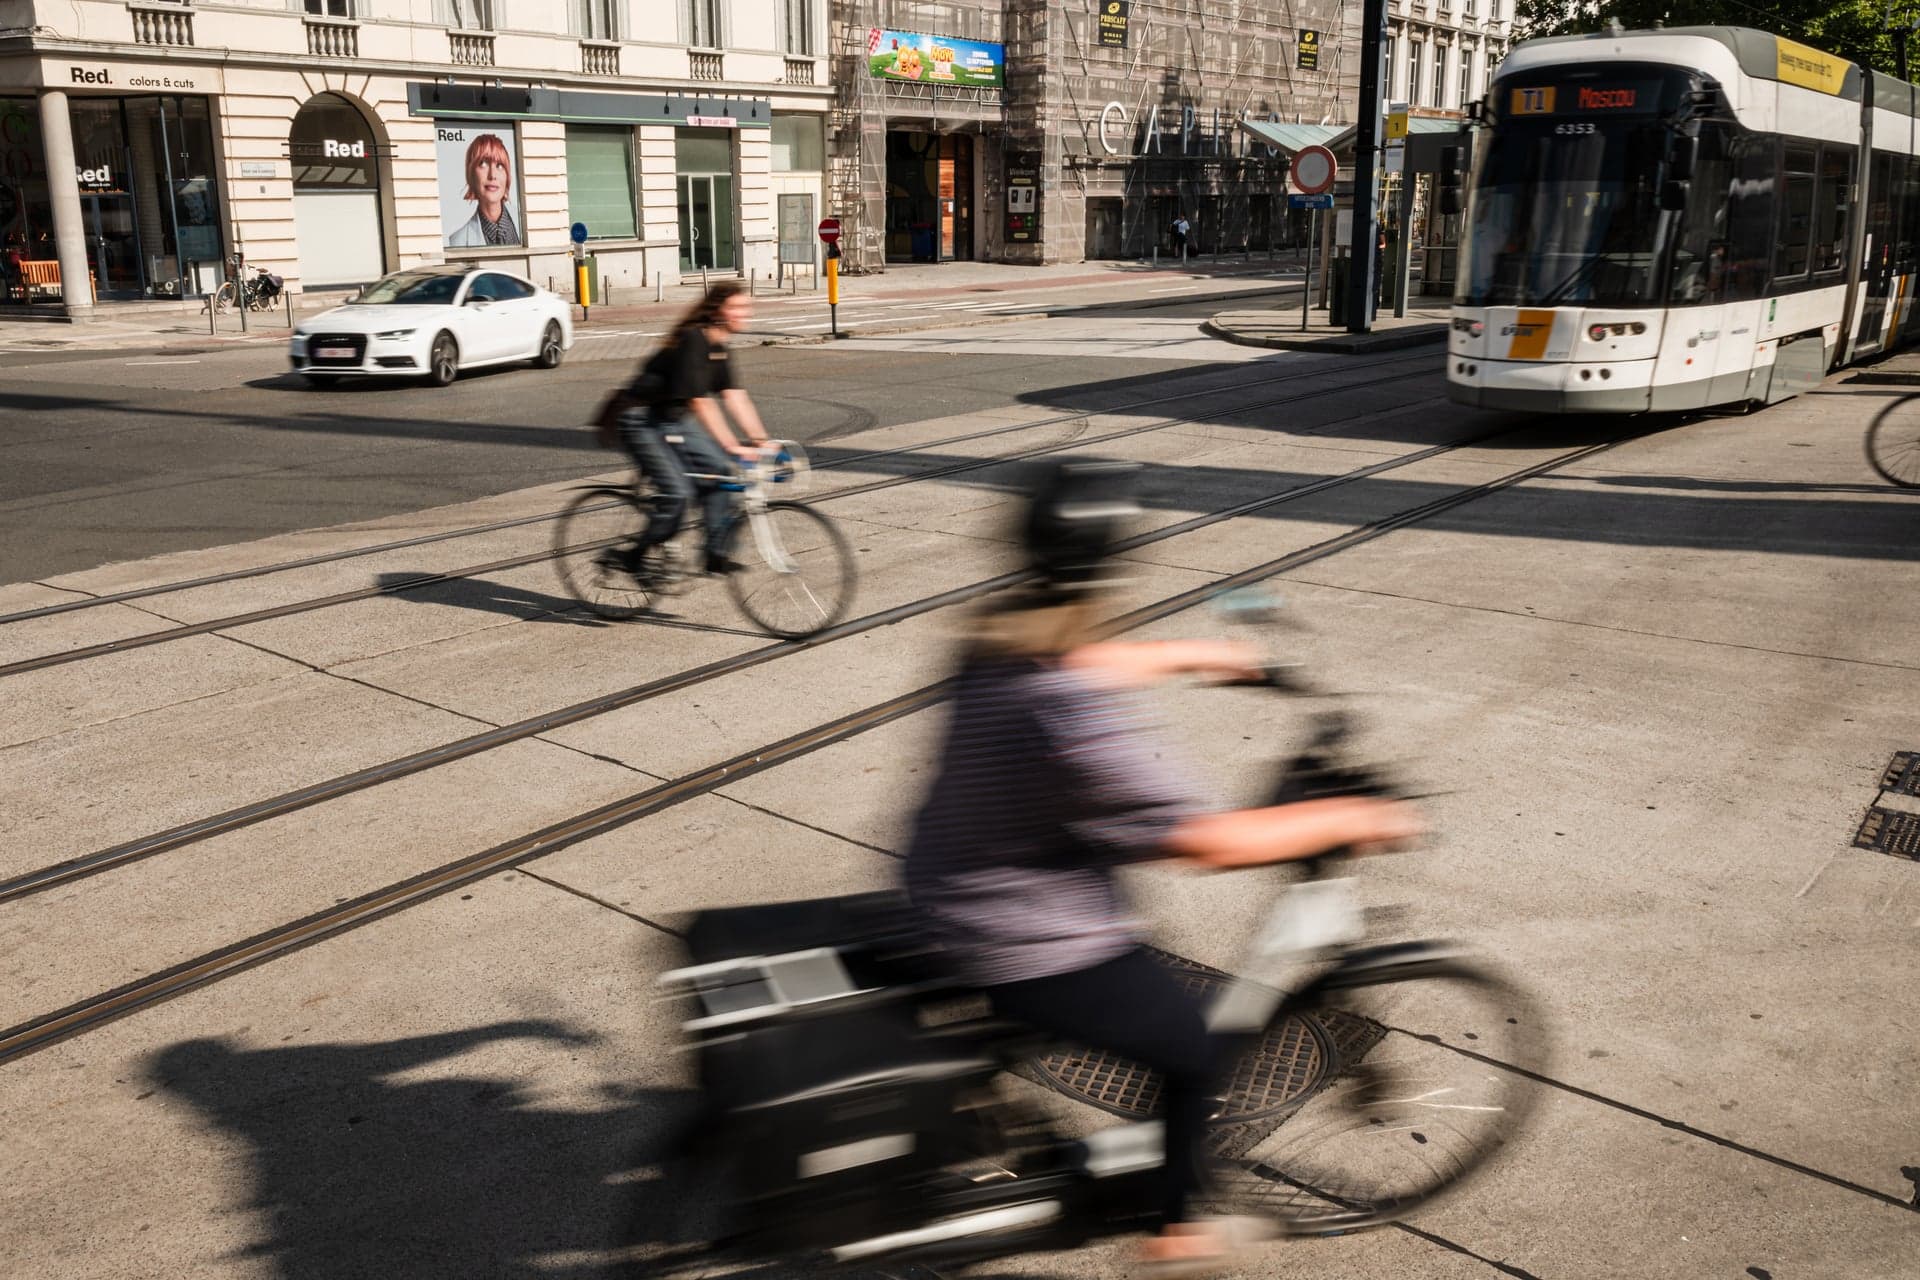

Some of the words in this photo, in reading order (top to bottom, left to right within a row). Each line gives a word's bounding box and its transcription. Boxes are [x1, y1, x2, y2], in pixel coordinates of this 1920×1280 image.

[70, 66, 113, 85] Red.
[129, 76, 161, 87] colors
[163, 78, 171, 87] &
[173, 79, 194, 88] cuts
[1522, 87, 1545, 112] T1
[1578, 86, 1636, 109] Moscou
[438, 129, 466, 142] Red.
[1555, 123, 1596, 135] 6353
[323, 139, 368, 158] Red.
